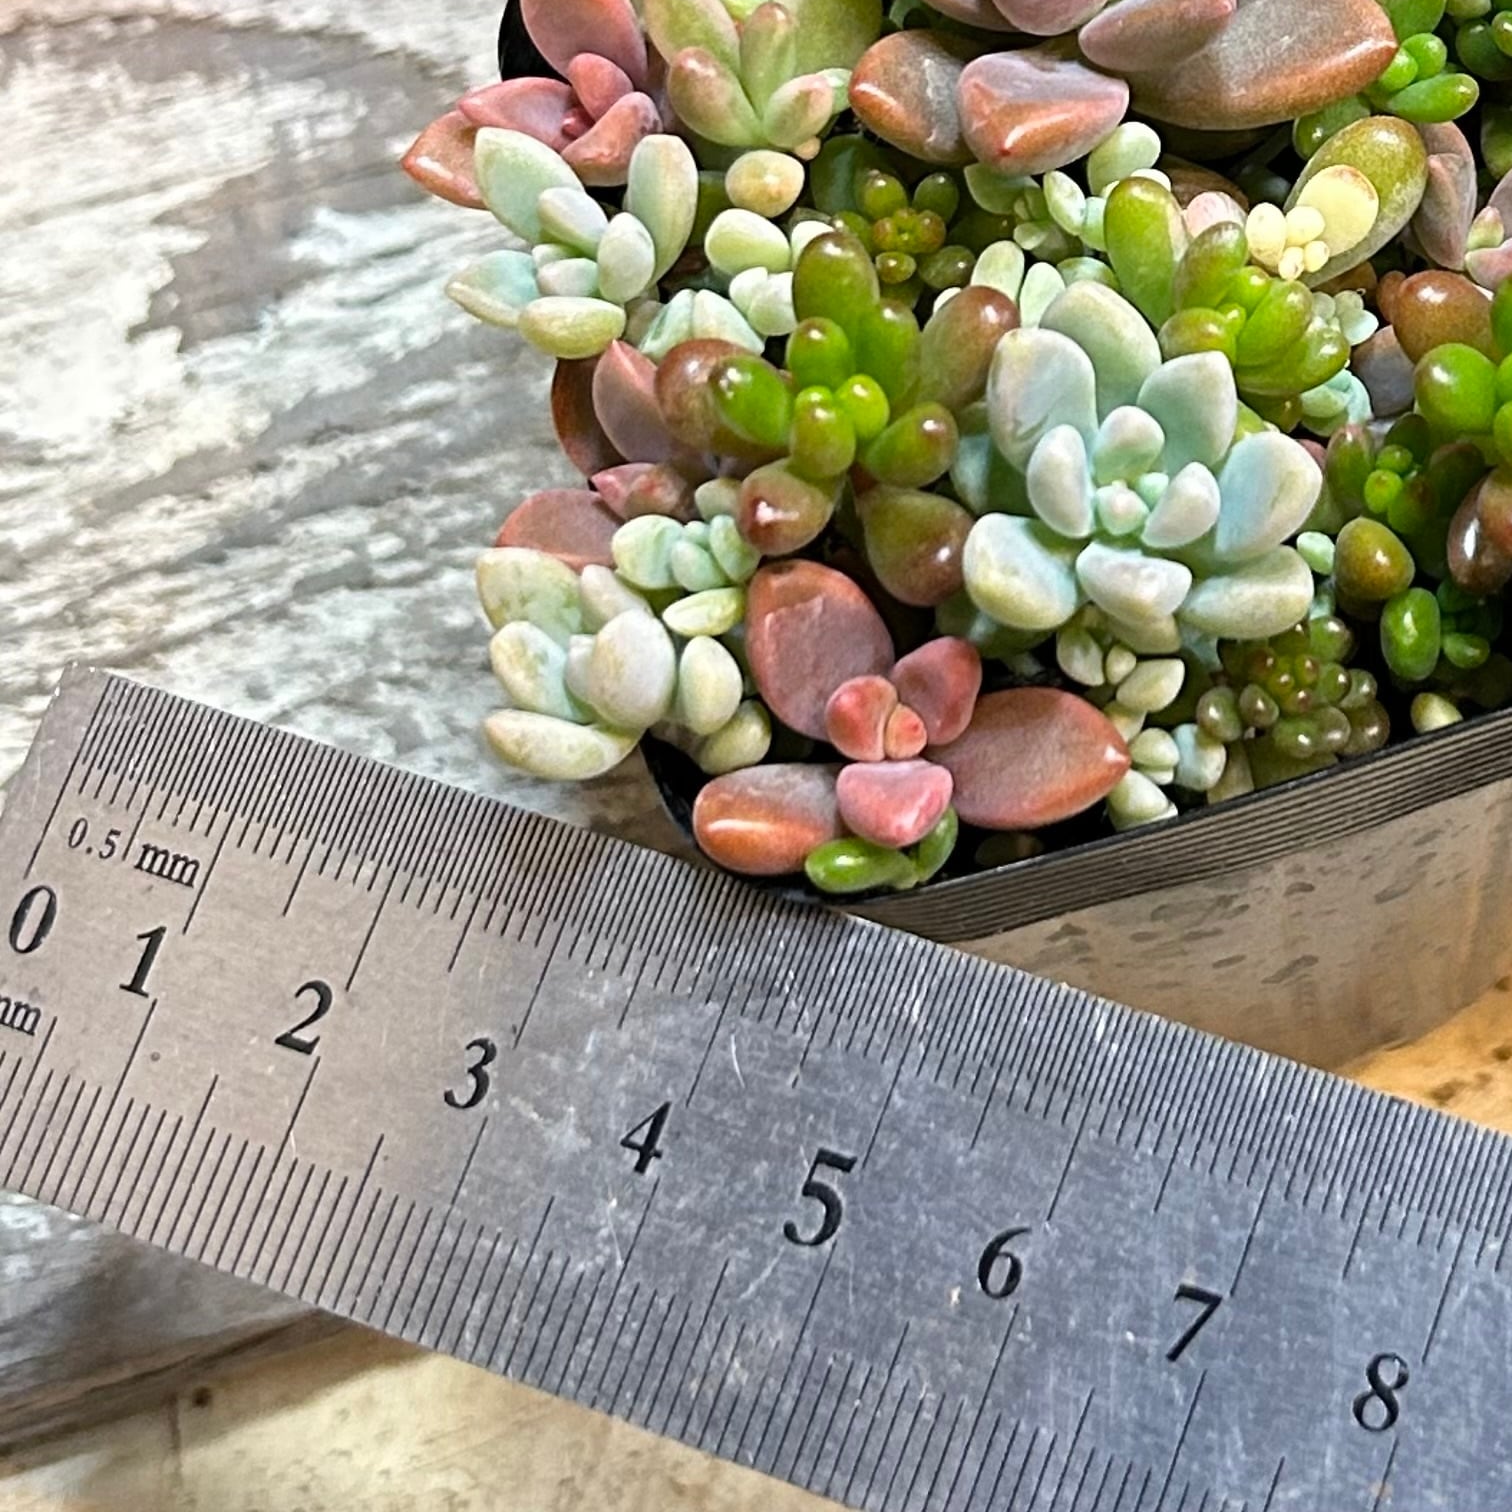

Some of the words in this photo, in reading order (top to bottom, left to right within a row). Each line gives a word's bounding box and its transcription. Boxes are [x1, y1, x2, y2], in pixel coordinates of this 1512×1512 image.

[68, 818, 121, 859] 0.5
[134, 843, 200, 888] mm
[9, 885, 57, 954] 0
[119, 926, 167, 998] 1
[275, 980, 333, 1055] 2
[444, 1038, 497, 1109] 3
[620, 1102, 672, 1174] 4
[783, 1148, 857, 1246] 5
[978, 1227, 1032, 1299] 6
[1167, 1283, 1222, 1362] 7
[1352, 1352, 1409, 1431] 8
